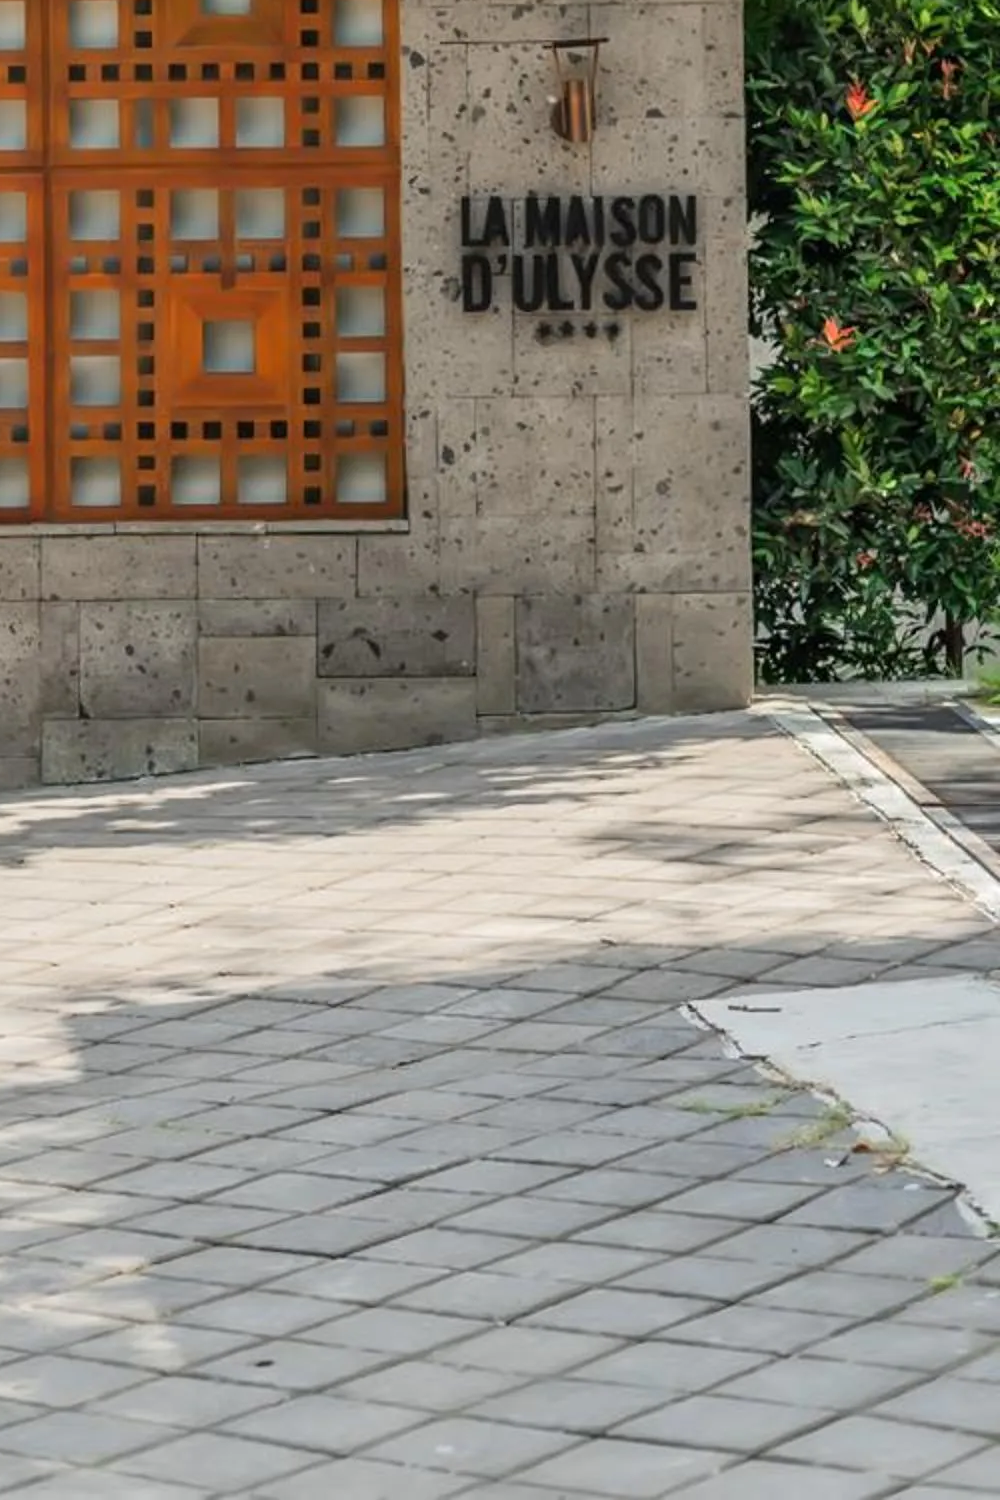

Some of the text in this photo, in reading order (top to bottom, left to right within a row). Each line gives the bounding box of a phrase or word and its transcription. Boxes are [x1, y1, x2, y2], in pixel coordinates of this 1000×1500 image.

[461, 194, 697, 248] LA MAISON
[462, 253, 697, 312] D'ULYSSE
